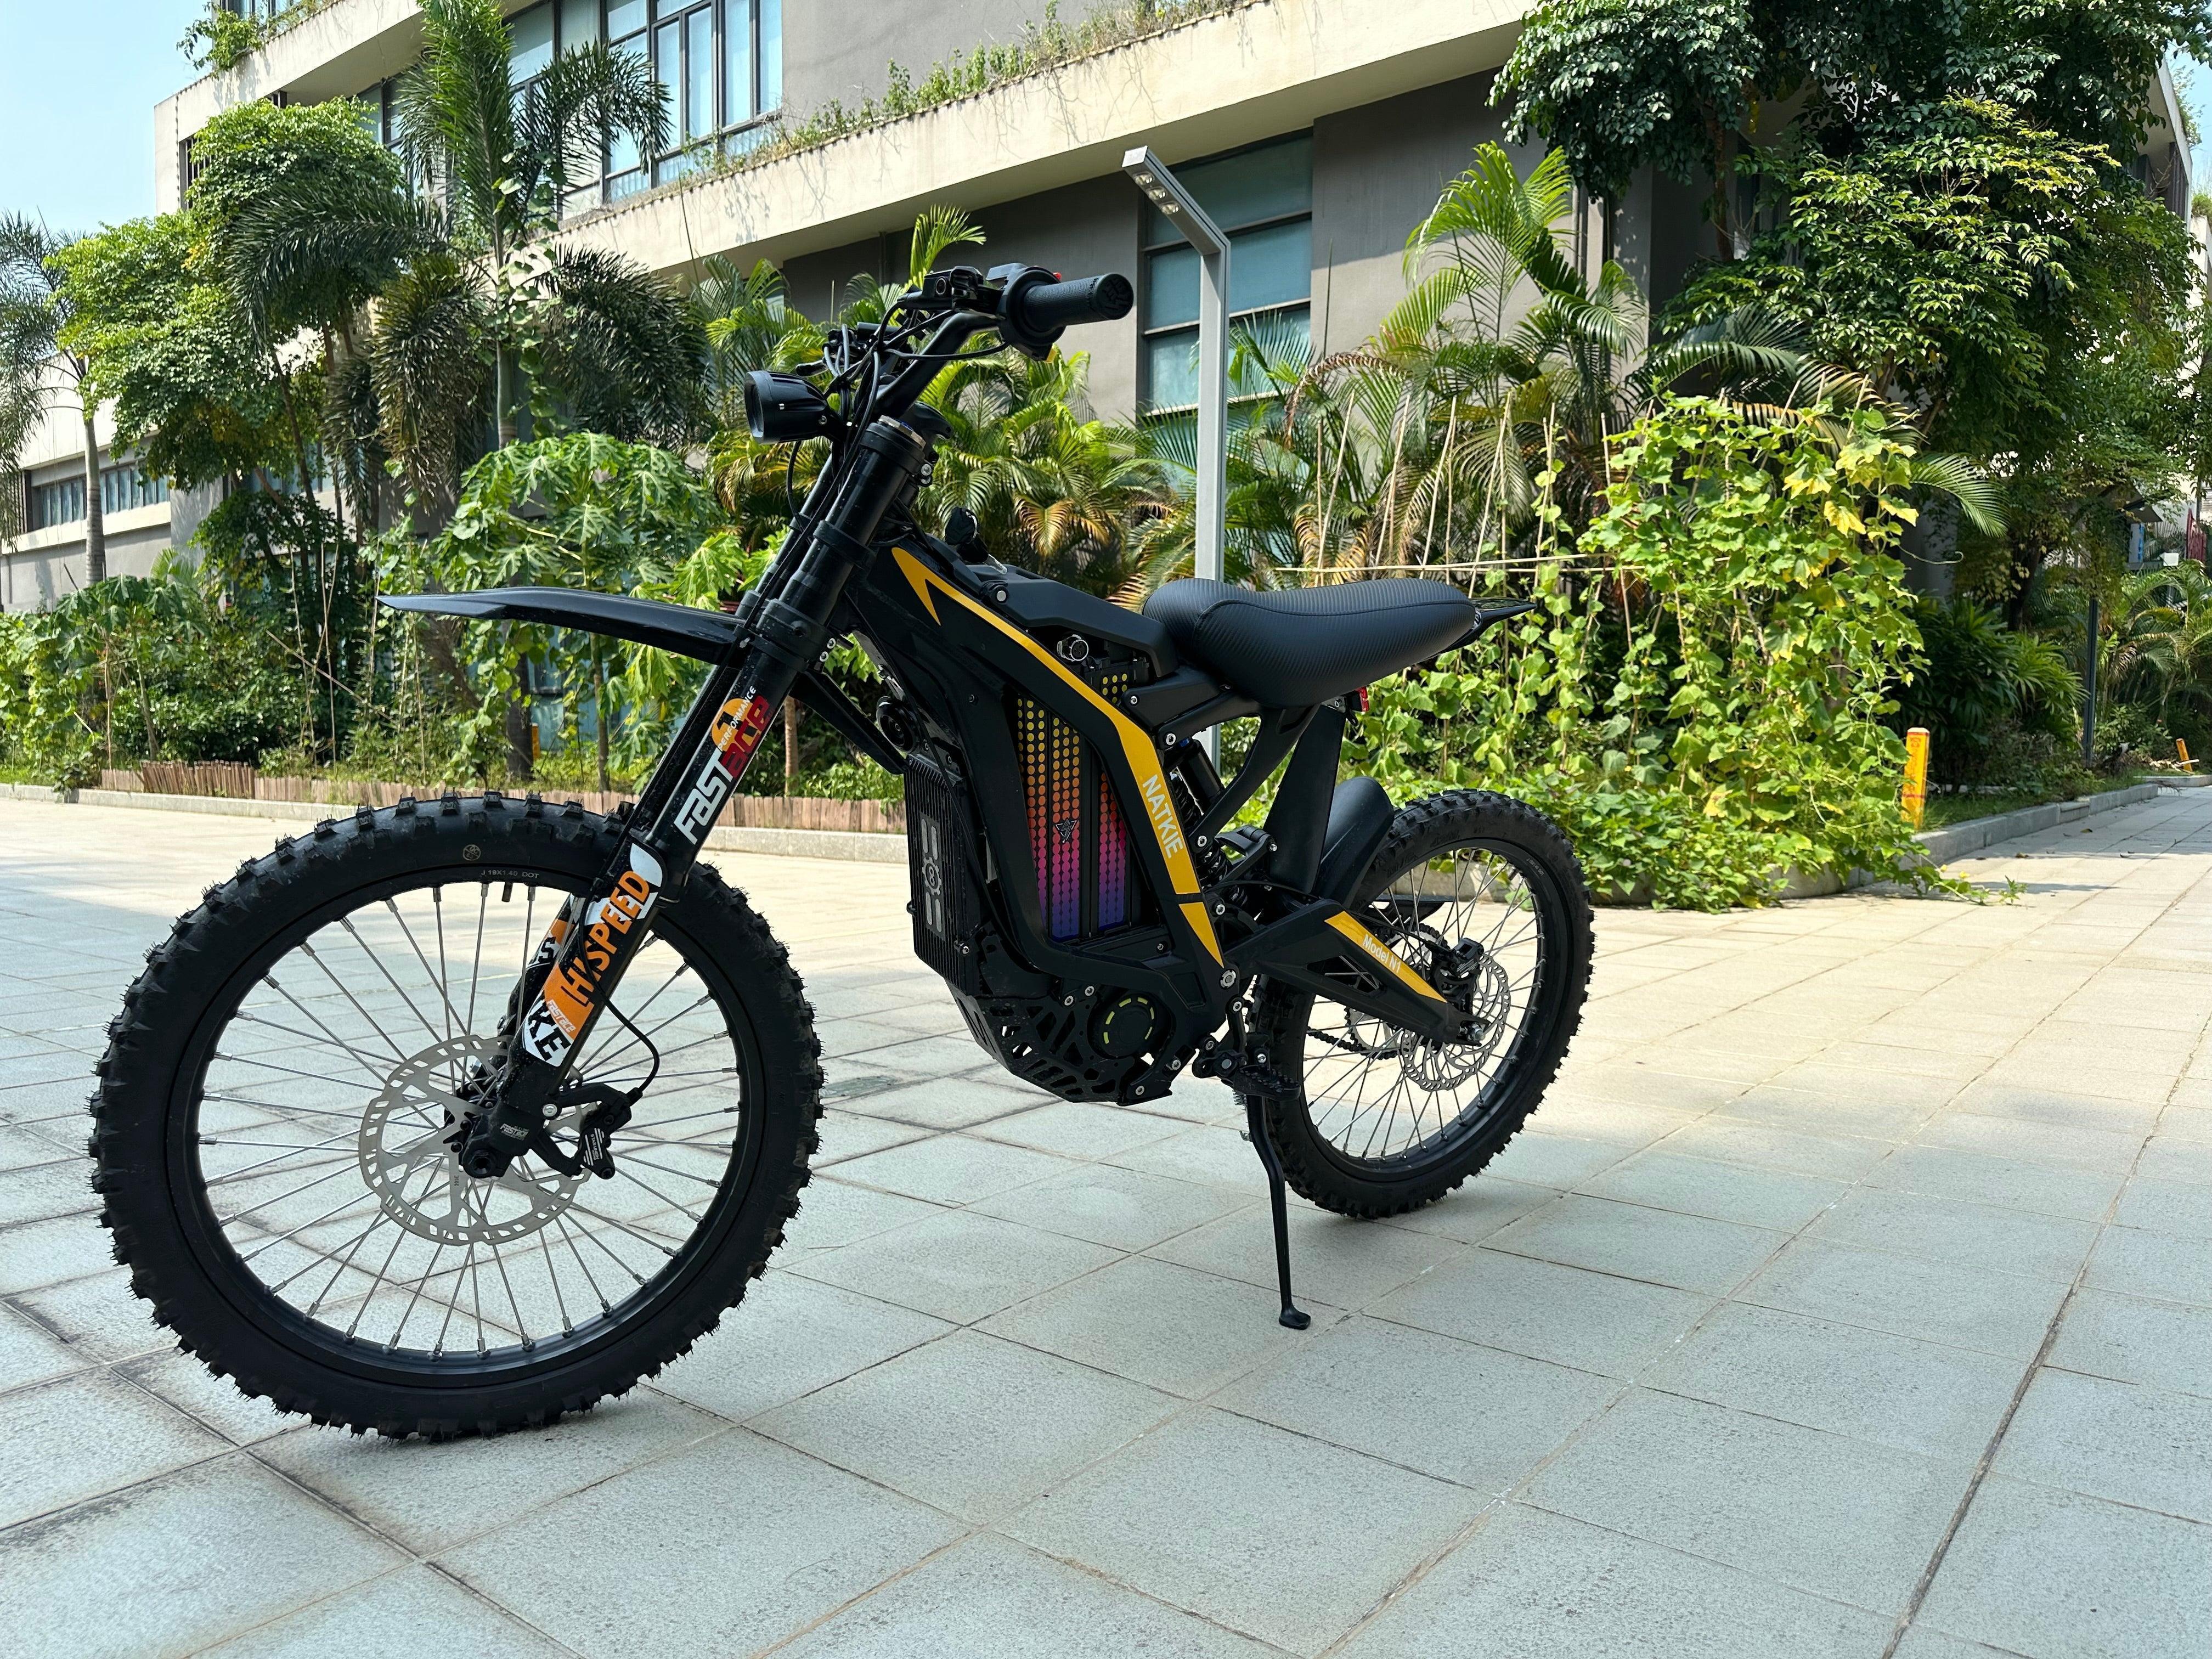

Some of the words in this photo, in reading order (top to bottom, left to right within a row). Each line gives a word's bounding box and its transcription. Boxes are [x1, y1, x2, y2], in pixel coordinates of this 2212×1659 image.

[718, 685, 756, 752] PERFORMANCE
[1142, 774, 1184, 859] NATKIE
[561, 871, 650, 1004] HISPEED
[1362, 934, 1389, 964] Model
[1389, 955, 1402, 973] N1
